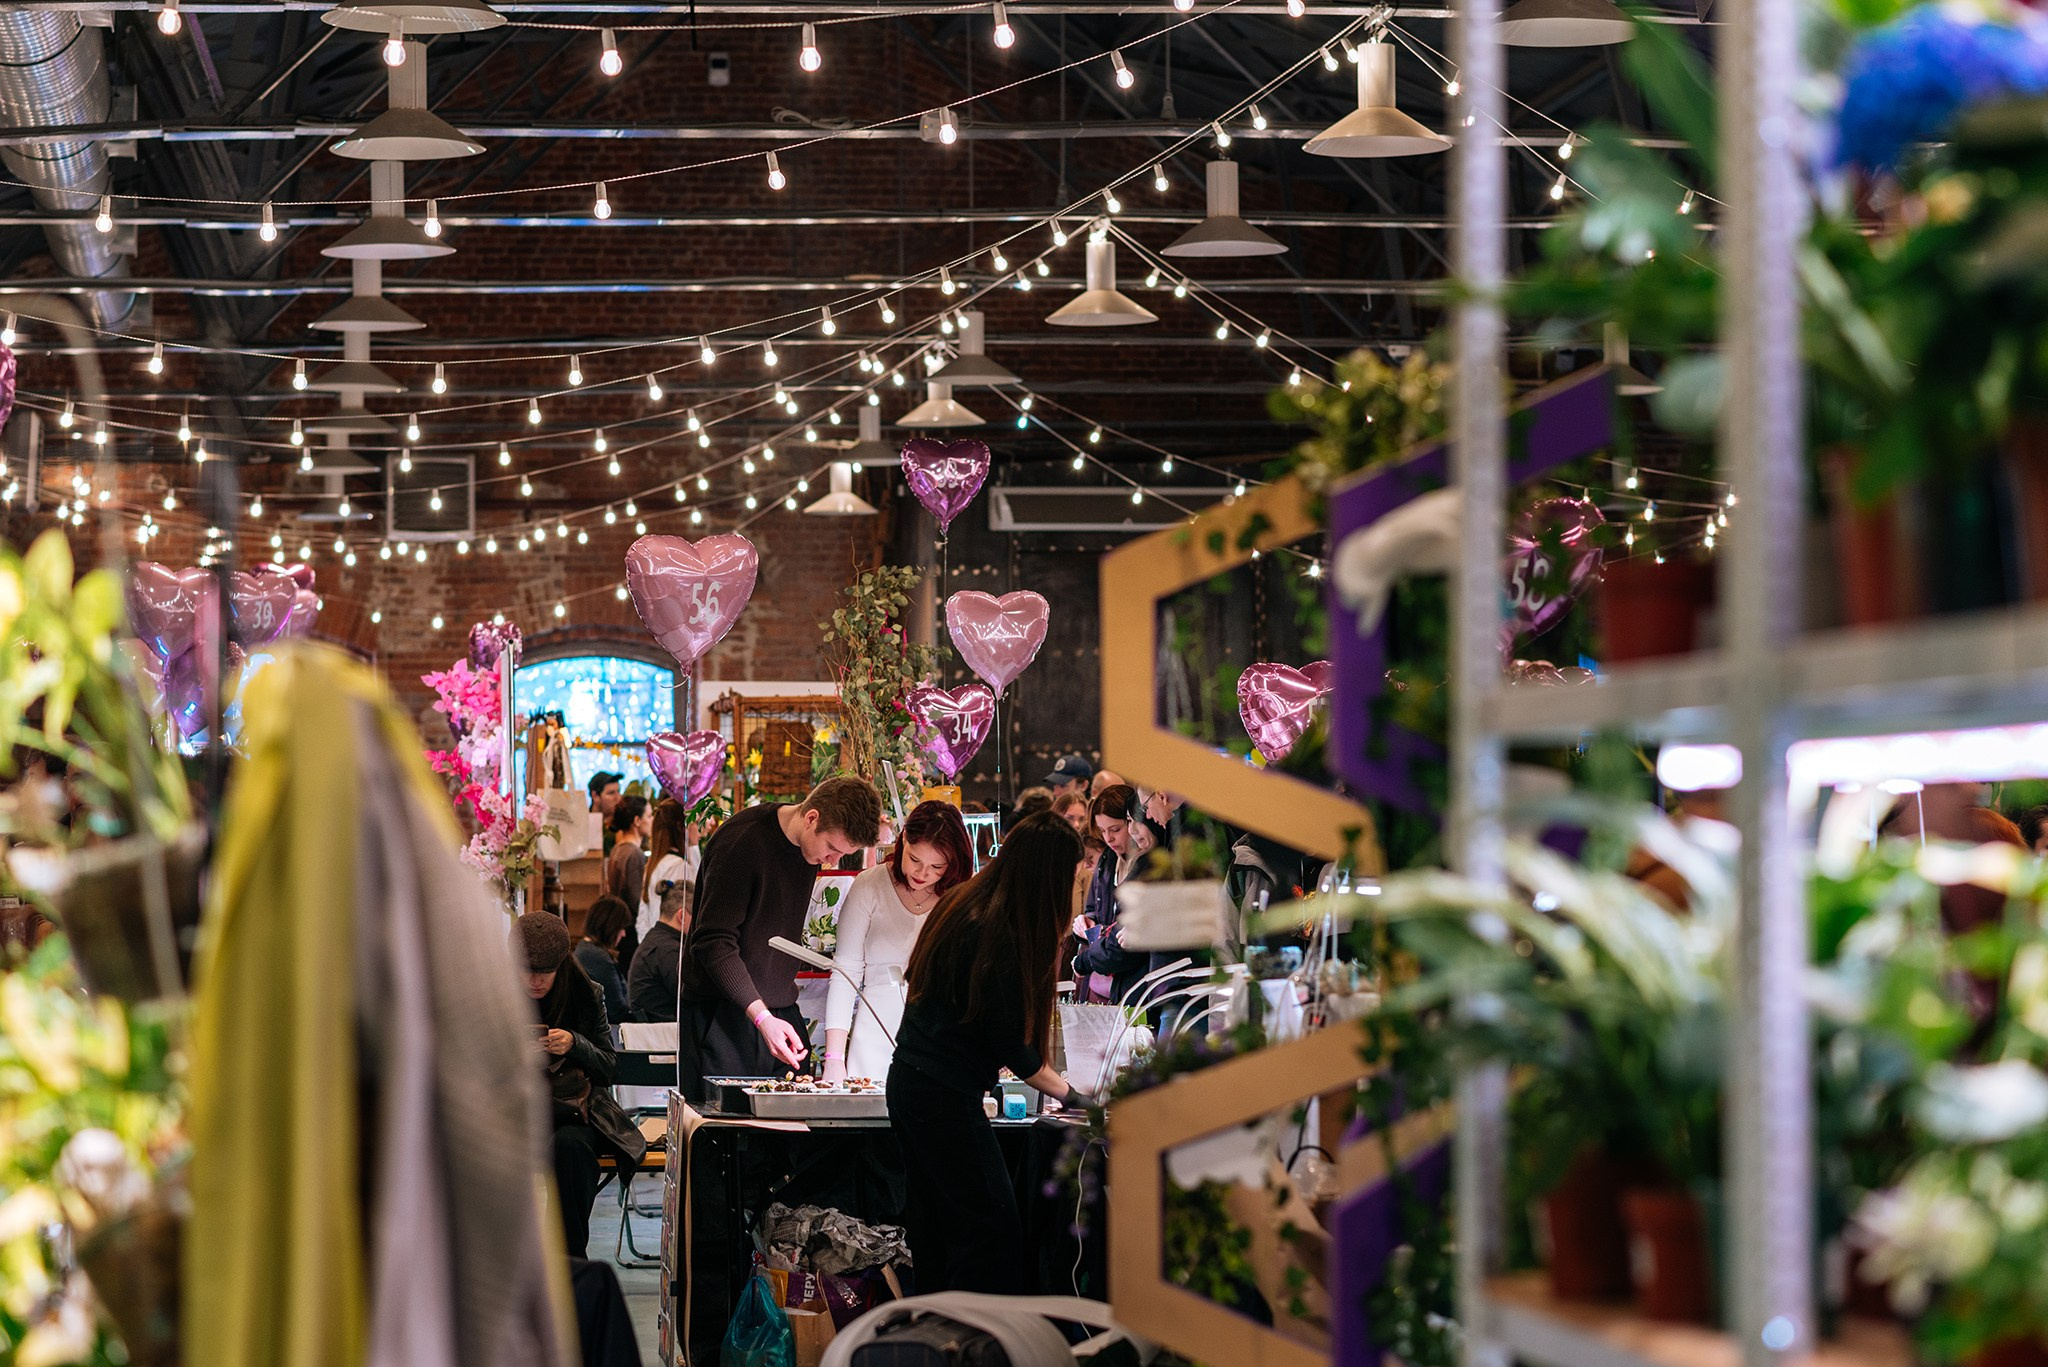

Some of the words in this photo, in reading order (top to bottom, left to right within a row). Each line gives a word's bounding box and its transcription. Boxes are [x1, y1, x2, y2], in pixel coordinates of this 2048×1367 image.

[252, 600, 272, 629] 39
[689, 581, 720, 625] 56
[951, 712, 972, 745] 34
